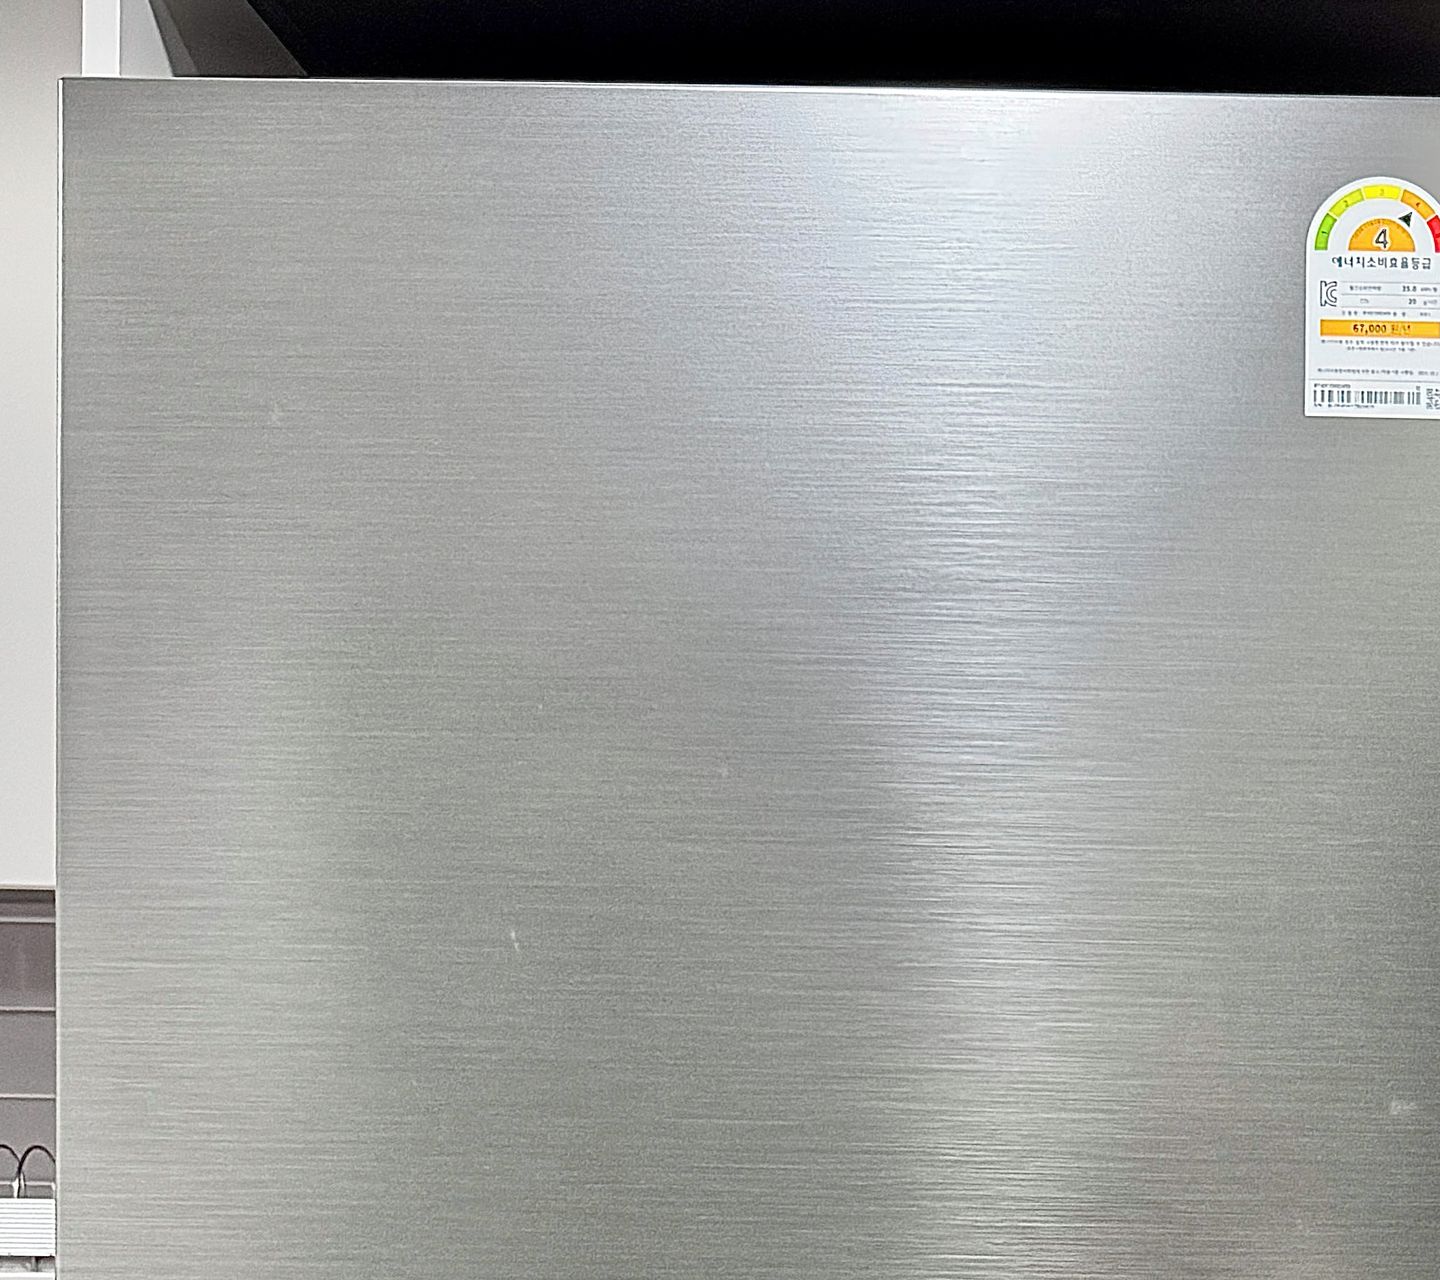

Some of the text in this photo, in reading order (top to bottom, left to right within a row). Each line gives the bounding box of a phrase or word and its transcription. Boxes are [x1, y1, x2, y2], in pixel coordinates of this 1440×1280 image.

[1374, 228, 1388, 249] 4
[1331, 255, 1431, 270] 에너지소비효율등급
[1353, 323, 1387, 335] 67,000
